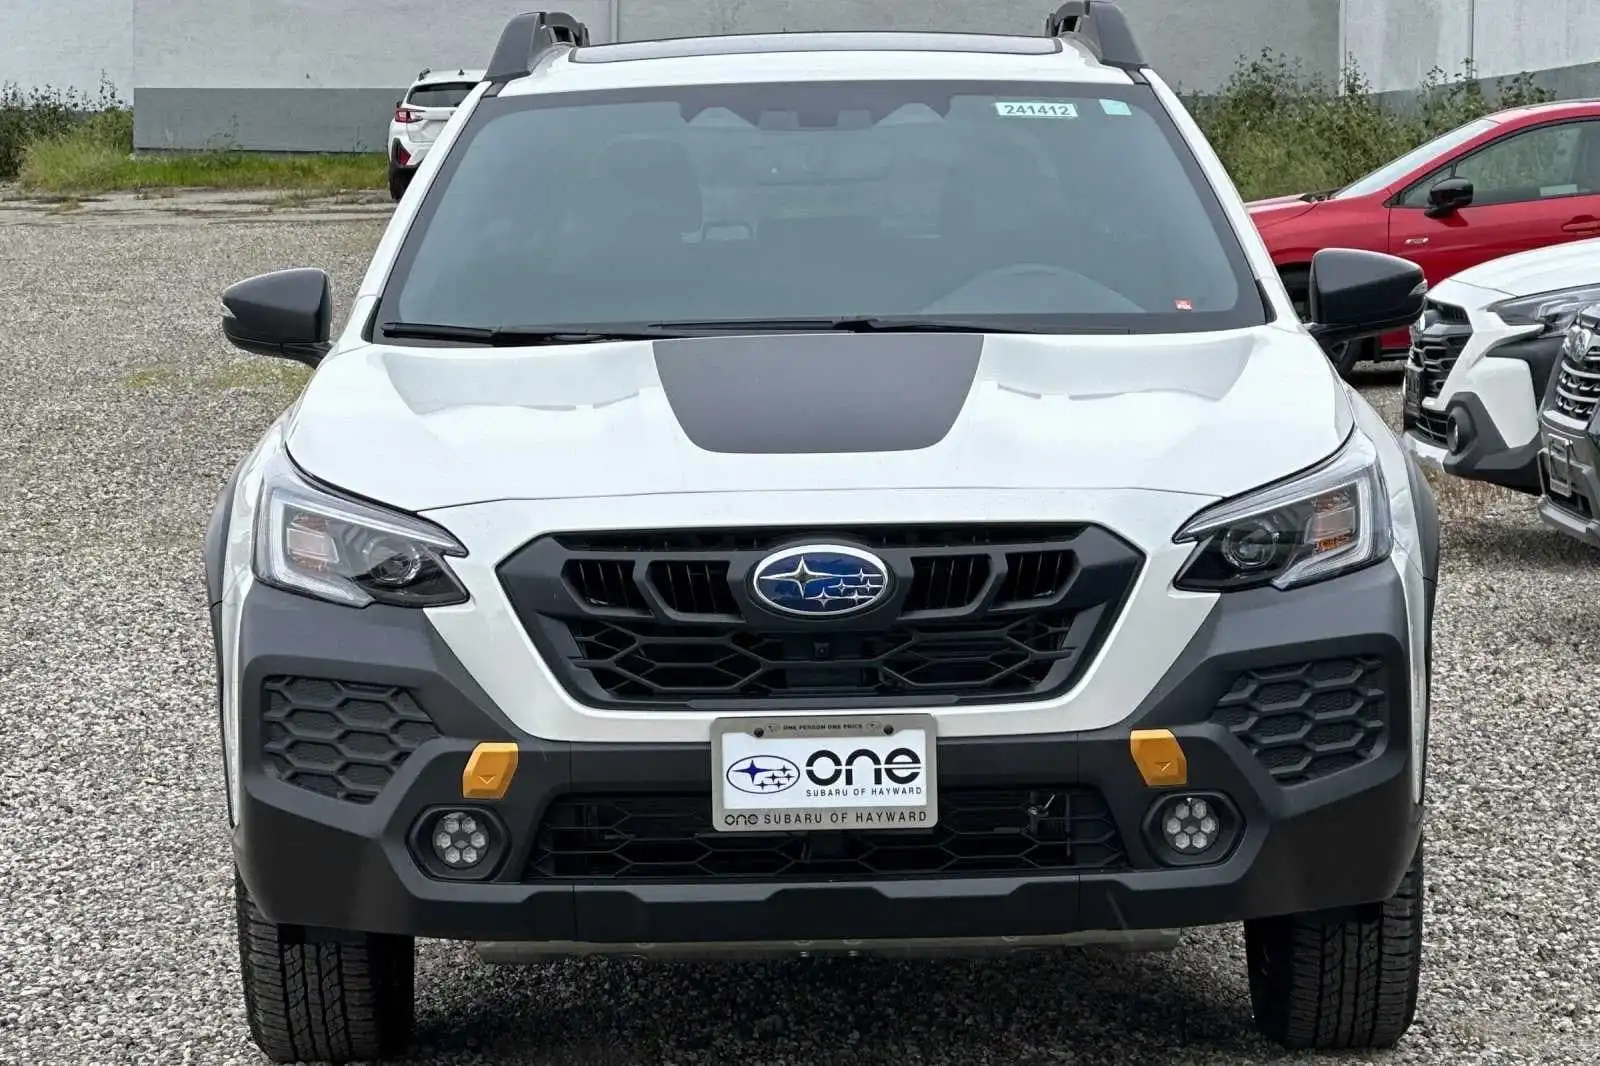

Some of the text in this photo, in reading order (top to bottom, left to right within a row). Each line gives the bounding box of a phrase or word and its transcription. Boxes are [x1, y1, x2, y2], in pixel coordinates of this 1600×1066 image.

[1004, 104, 1070, 116] 241412
[805, 747, 922, 786] one
[806, 786, 922, 797] SUBARU OF HAYWARD
[764, 813, 822, 825] SUBARU
[830, 812, 847, 824] OF
[856, 811, 927, 823] HAYWARD
